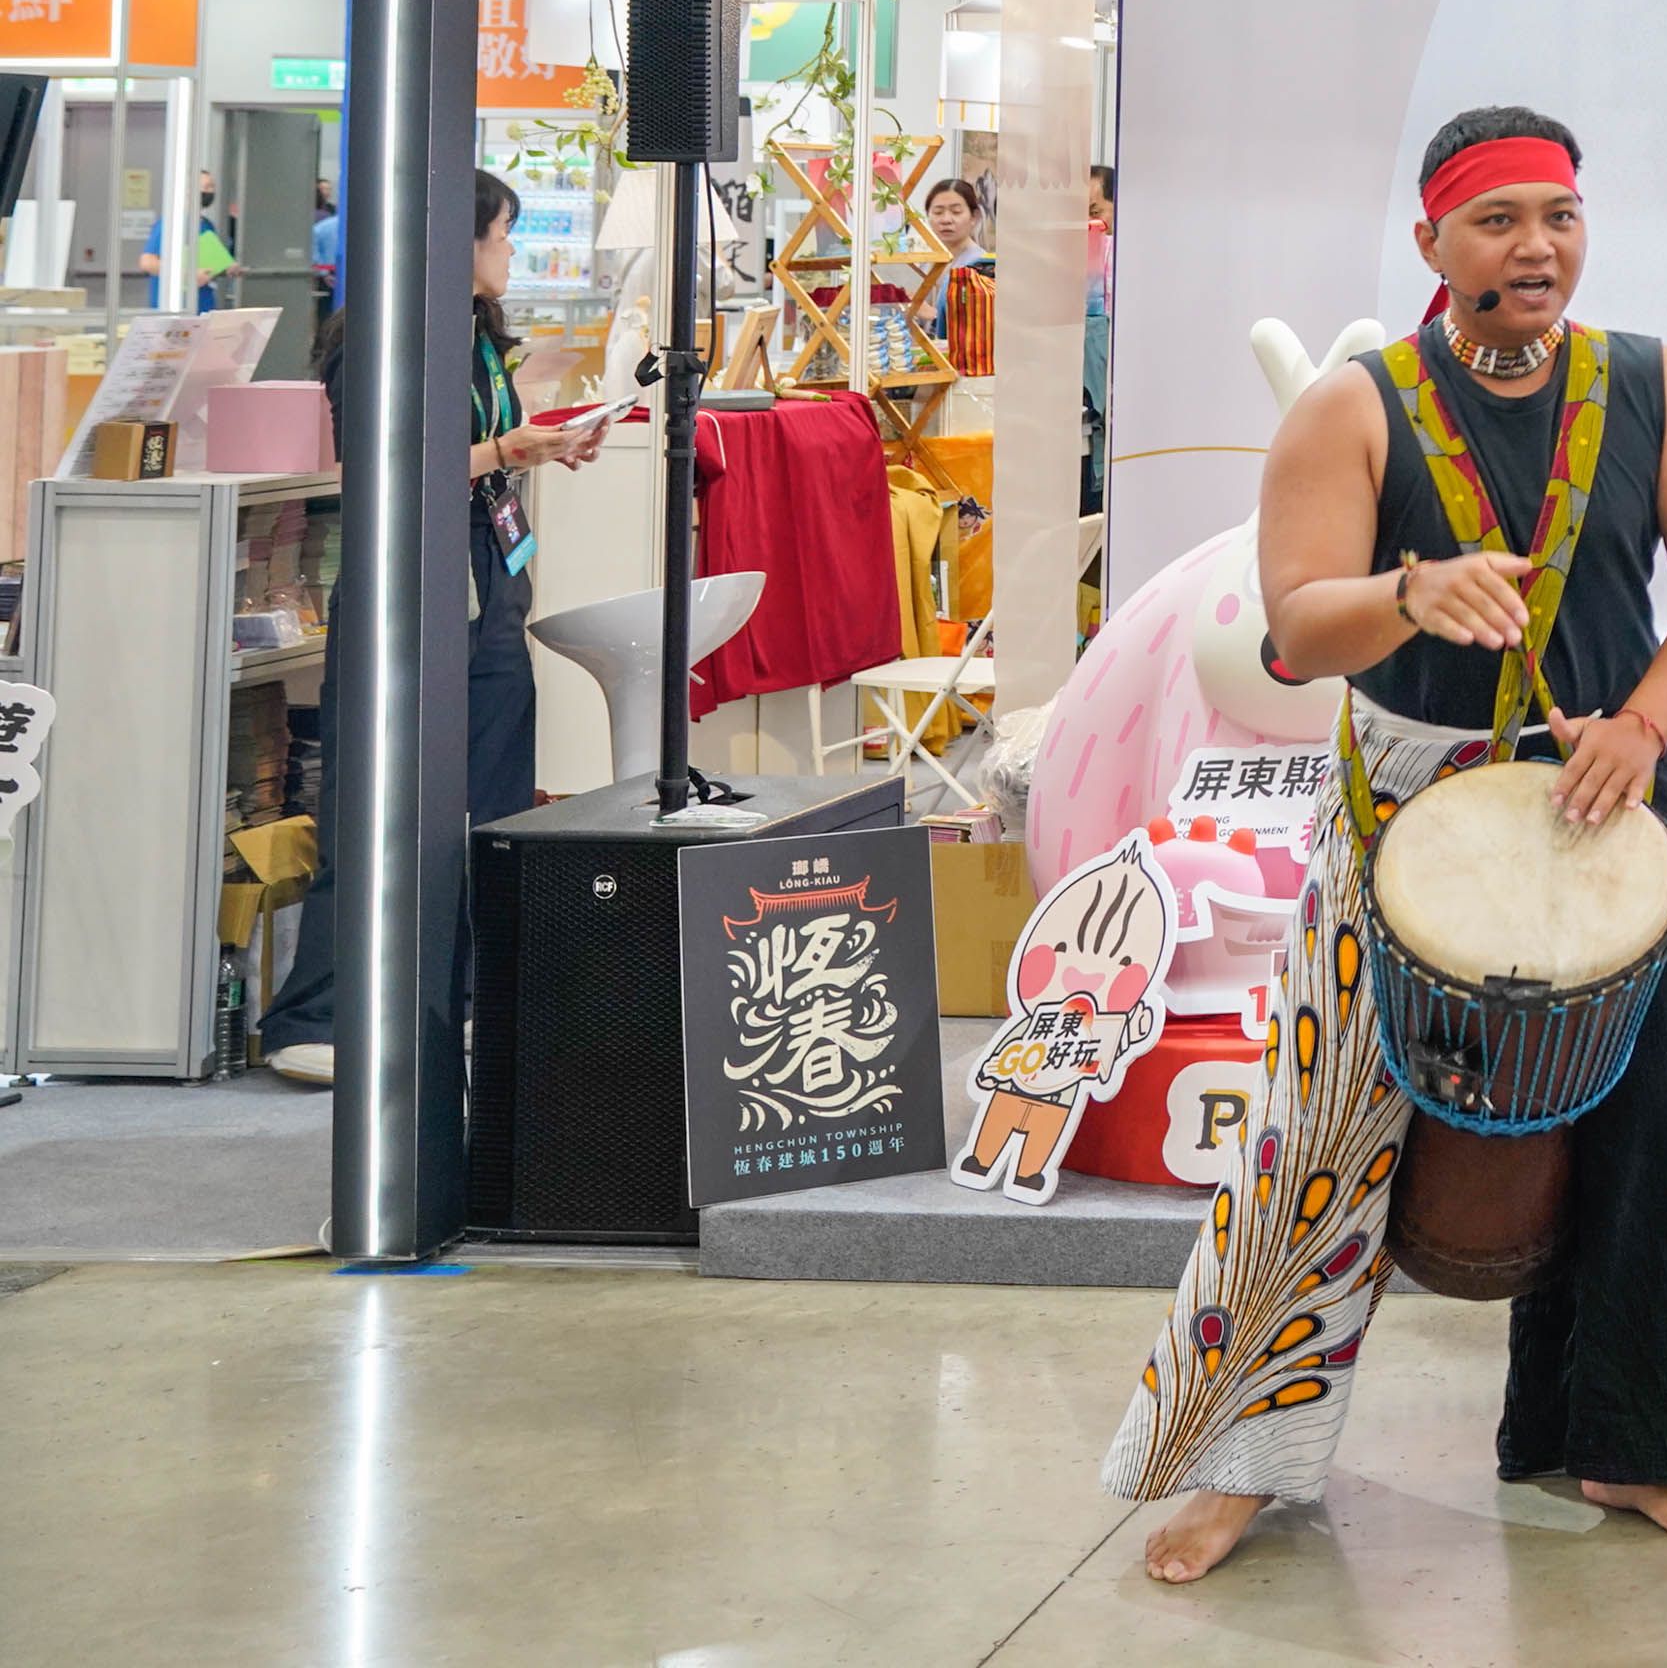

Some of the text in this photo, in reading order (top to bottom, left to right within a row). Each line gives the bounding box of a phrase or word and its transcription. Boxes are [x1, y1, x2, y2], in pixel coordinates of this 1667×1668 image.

[1028, 1010, 1086, 1040] 屏東
[734, 1123, 903, 1154] HENGCHUN TOWNSHIP
